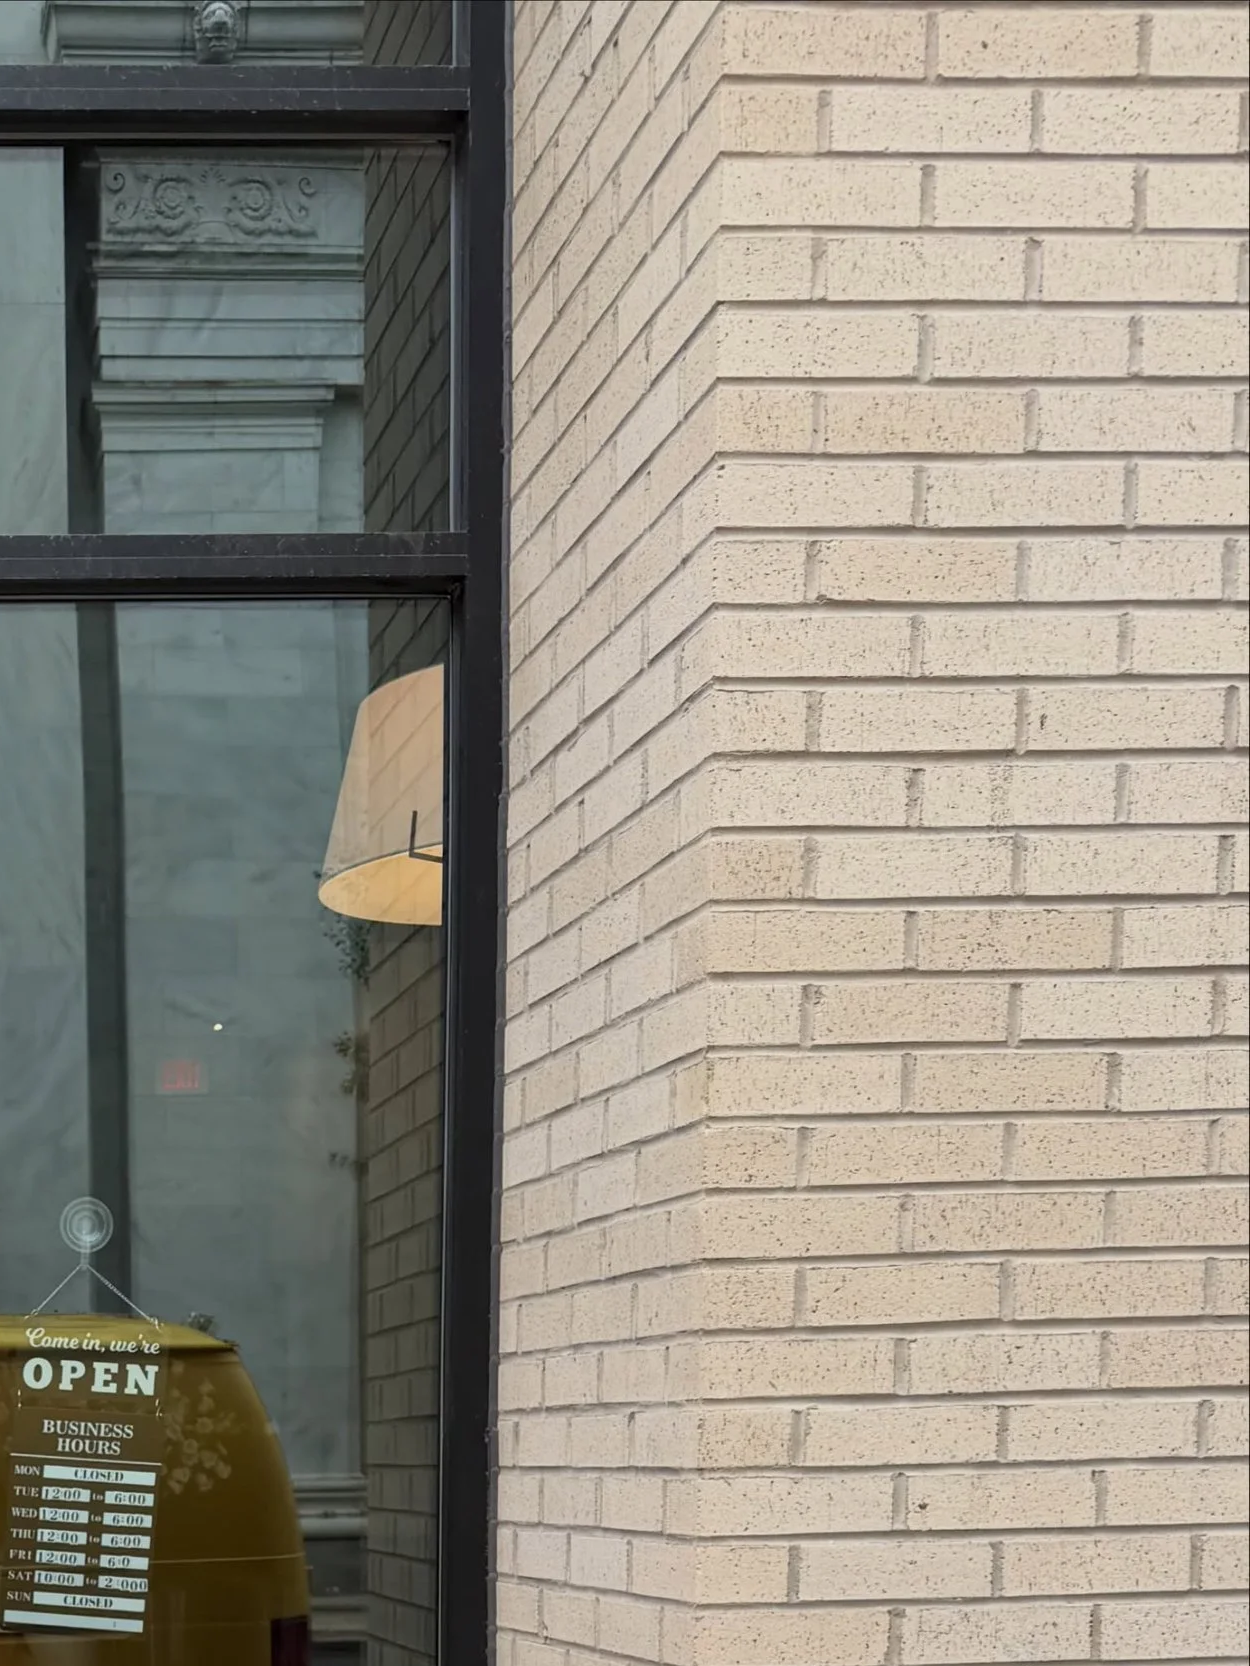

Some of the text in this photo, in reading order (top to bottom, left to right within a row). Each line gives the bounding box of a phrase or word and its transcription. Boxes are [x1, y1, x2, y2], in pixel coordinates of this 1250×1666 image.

[26, 1327, 160, 1354] Come in, we're
[23, 1357, 159, 1395] OPEN
[42, 1419, 134, 1439] BUSINESS
[57, 1437, 121, 1455] HOURS
[14, 1464, 124, 1482] MON CLOSED
[13, 1486, 146, 1505] TUE 12:00 to 6:00
[11, 1507, 144, 1527] WED 12:00 to 6:00
[10, 1528, 141, 1547] THU 12:00 to 6:00
[9, 1549, 32, 1560] FRI
[38, 1551, 77, 1564] 12:00
[87, 1556, 98, 1564] to
[8, 1570, 33, 1581] SAT
[37, 1572, 75, 1585] 10:00
[86, 1577, 97, 1585] to
[6, 1591, 113, 1608] SUN CLOSED
